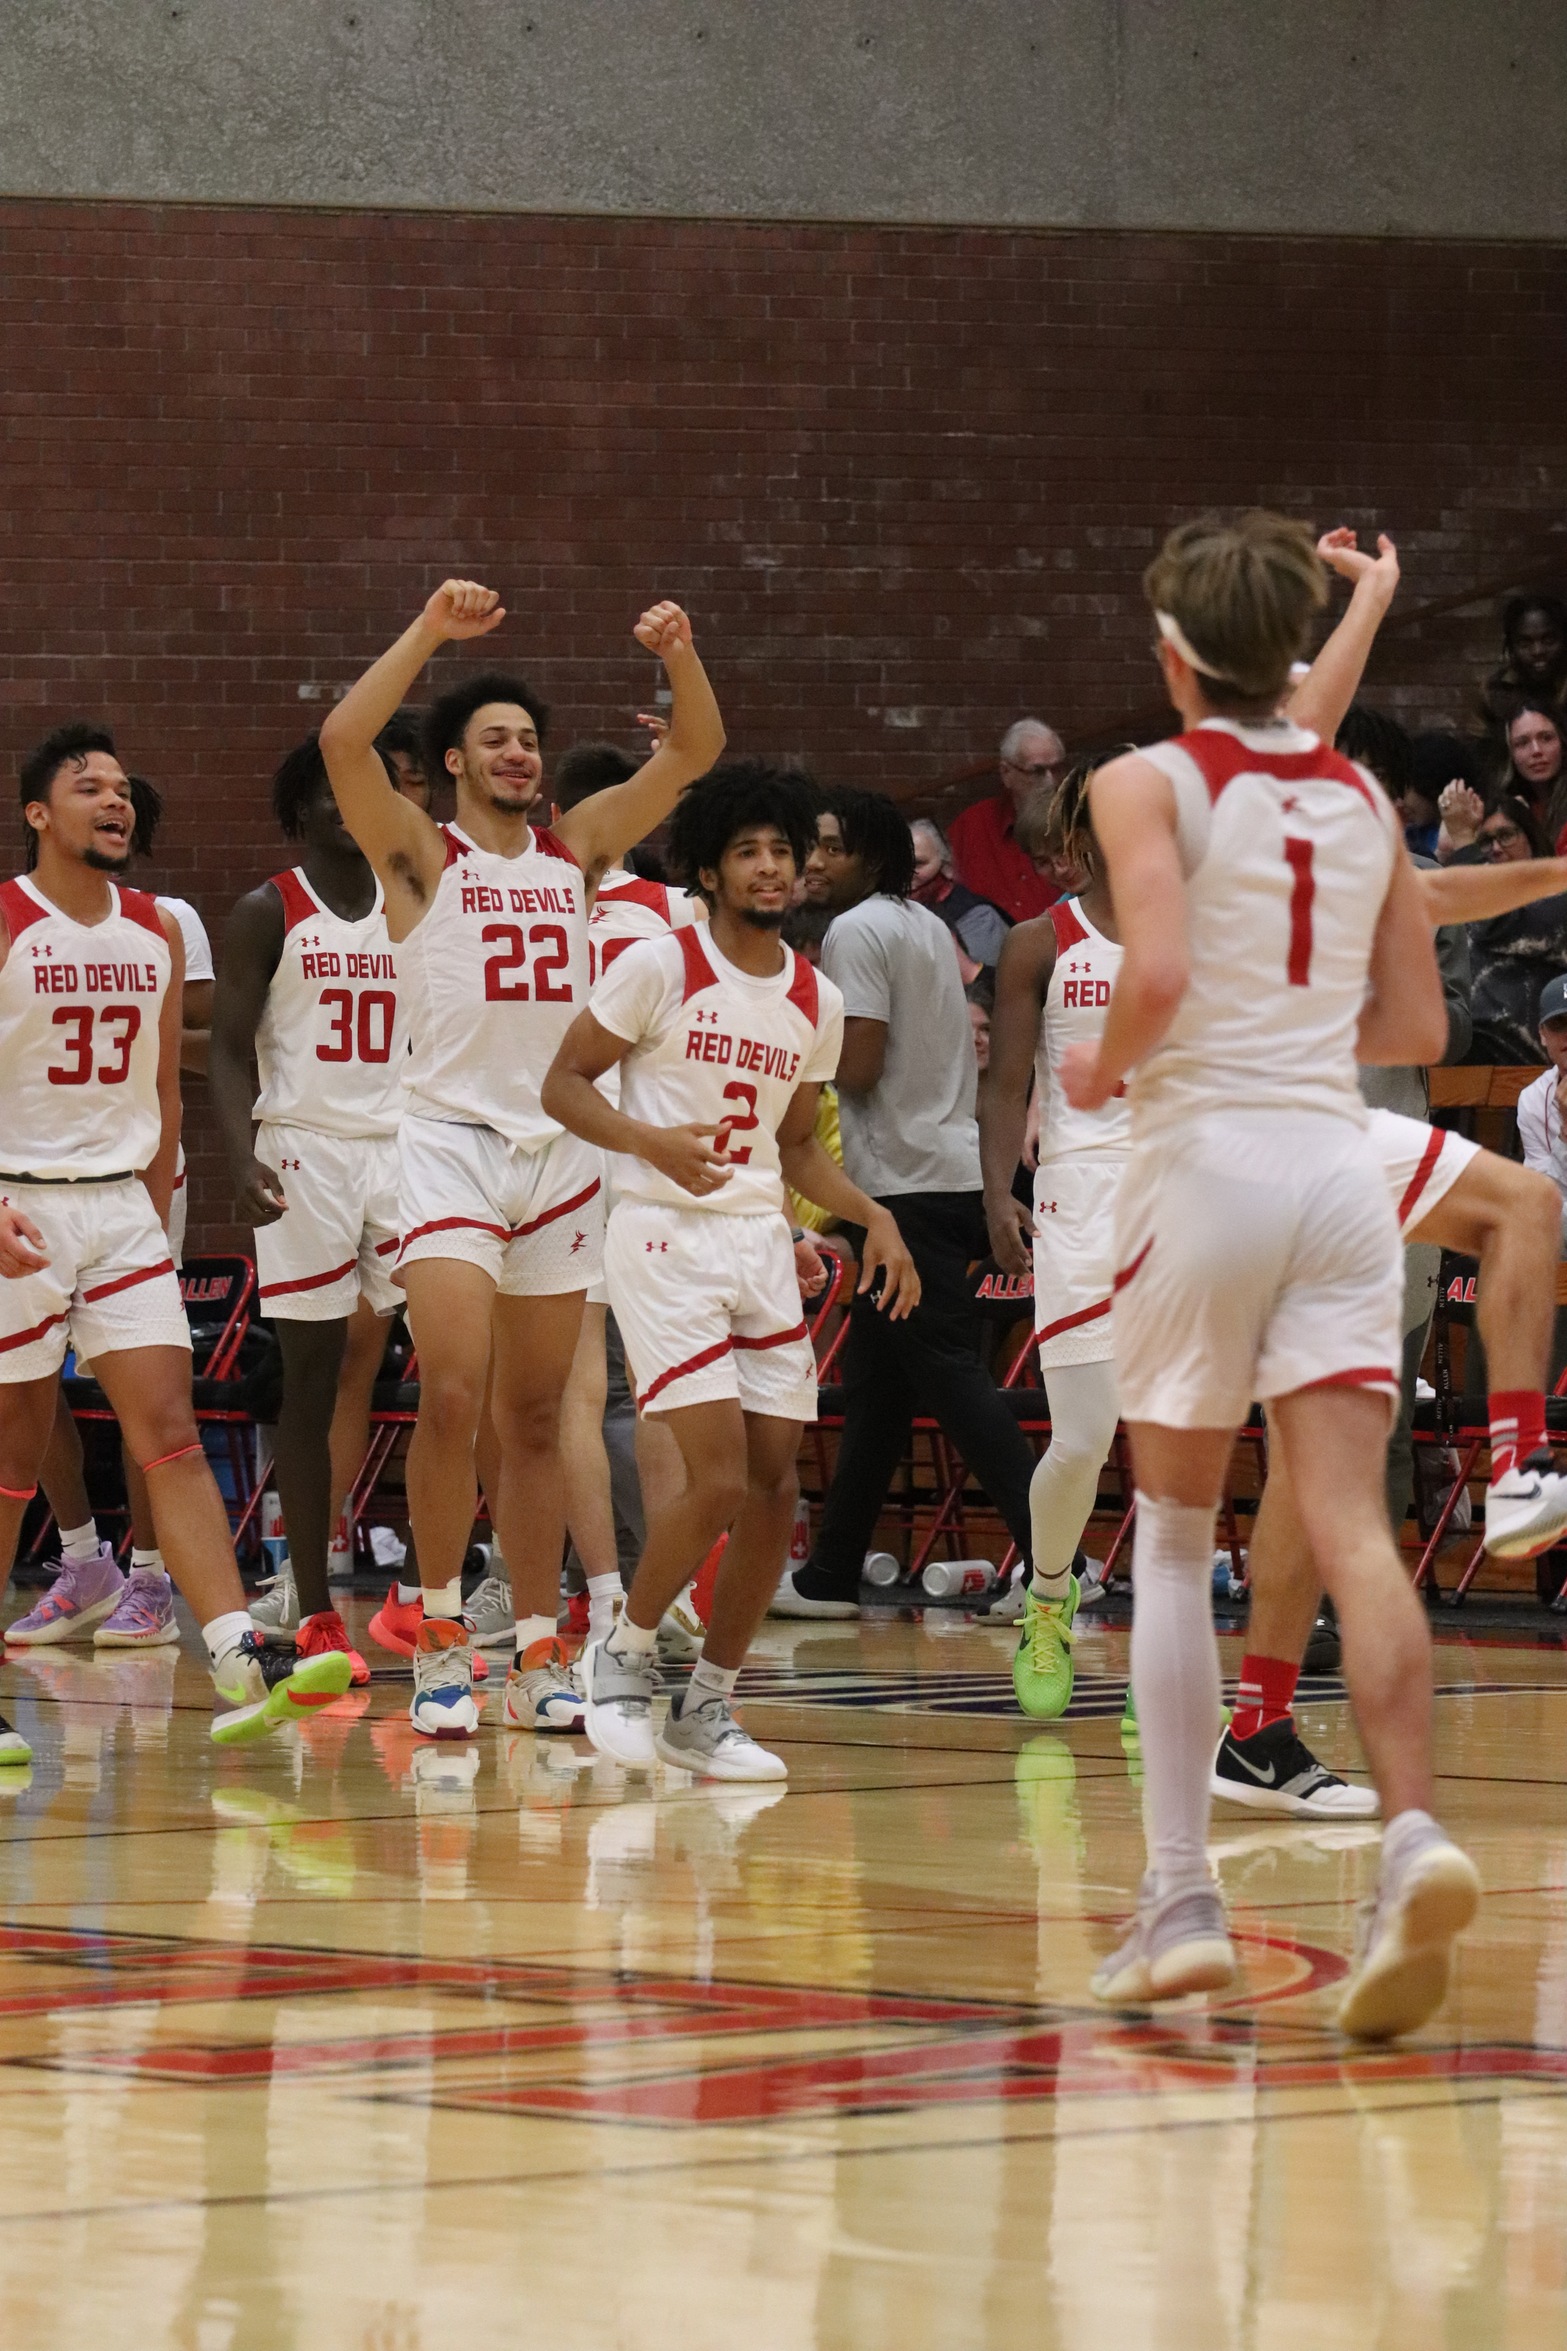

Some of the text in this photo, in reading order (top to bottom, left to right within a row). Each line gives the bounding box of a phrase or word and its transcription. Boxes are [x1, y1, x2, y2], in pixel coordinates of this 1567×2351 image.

[461, 886, 575, 914] RED DEVILS
[1284, 836, 1315, 986] 1
[33, 964, 157, 993] RED DEVILS
[301, 952, 397, 979] RED DEVIL
[482, 924, 573, 1002] 22
[1064, 981, 1110, 1008] RED
[48, 1005, 141, 1084] 33
[316, 988, 396, 1063] 30
[686, 1030, 801, 1082] RED DEVILS
[713, 1081, 759, 1165] 2
